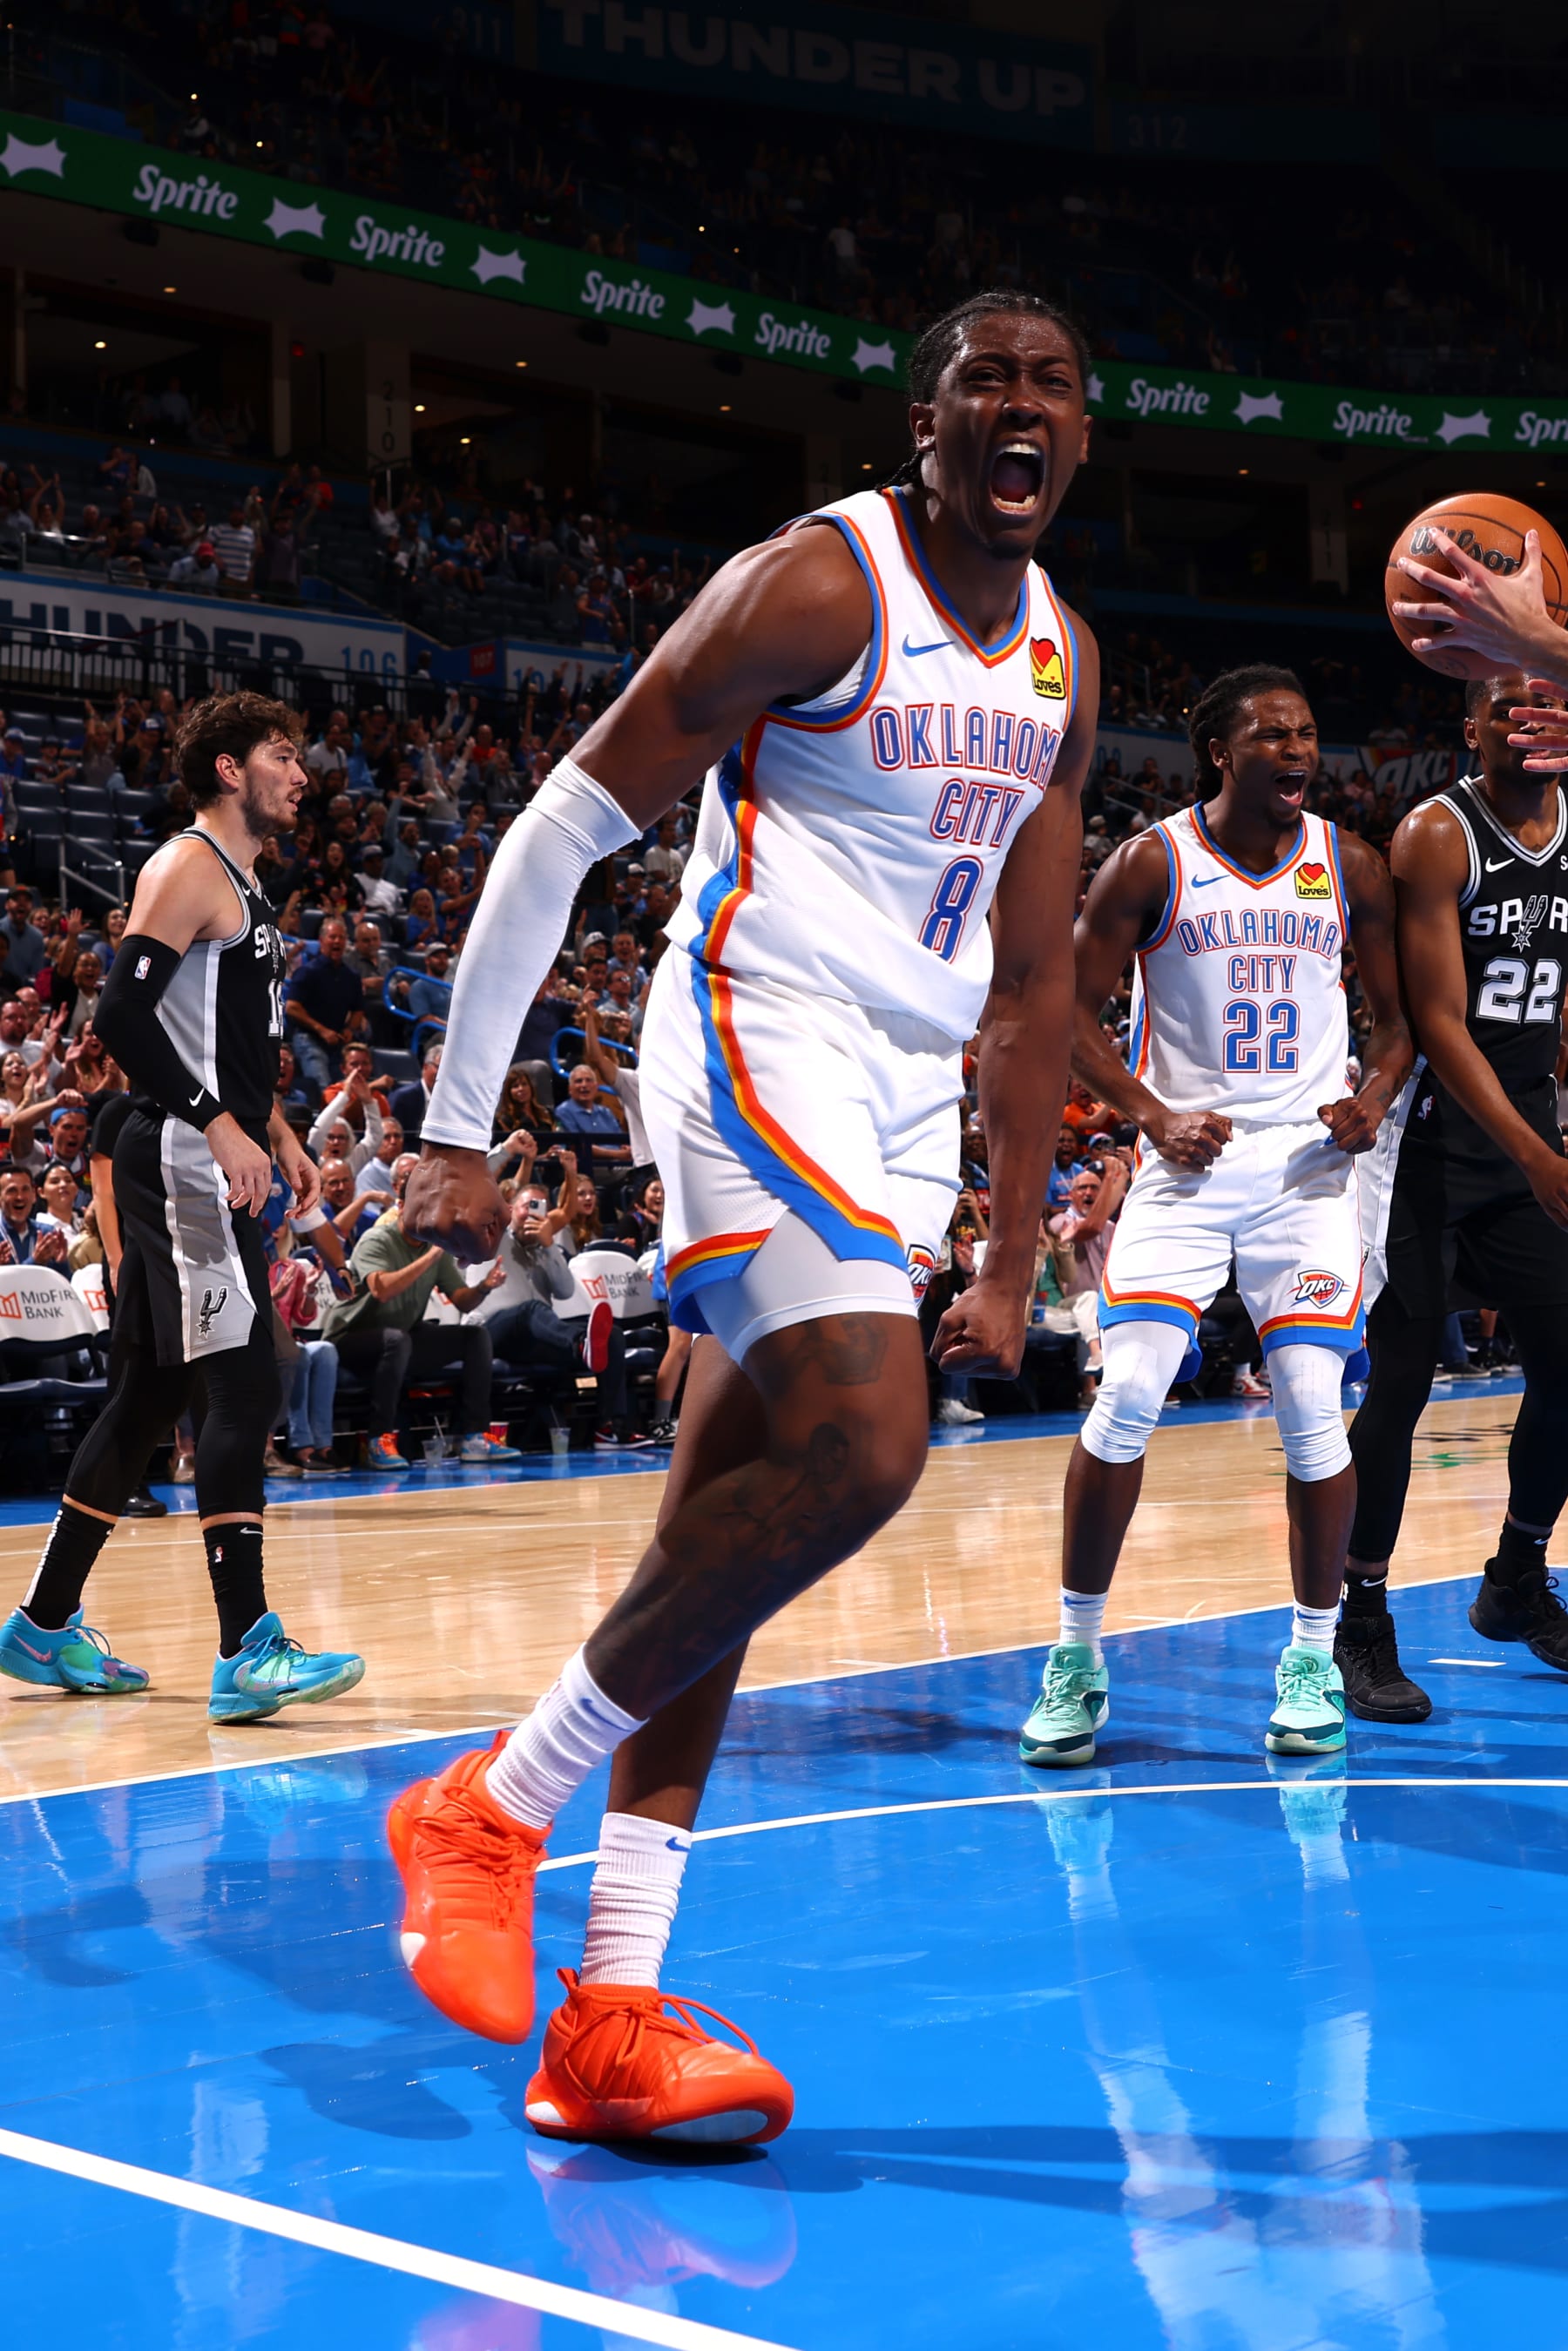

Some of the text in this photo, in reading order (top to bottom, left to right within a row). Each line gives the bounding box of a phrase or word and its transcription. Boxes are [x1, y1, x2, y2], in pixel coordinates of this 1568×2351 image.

[544, 0, 1086, 116] THUNDER UP
[132, 163, 239, 220] Sprite
[349, 214, 445, 267] Sprite
[580, 269, 666, 320] Sprite
[754, 311, 832, 359] Sprite
[1125, 377, 1211, 417] Sprite
[1333, 399, 1413, 438] Sprite
[1514, 410, 1568, 448] Spr
[869, 702, 1062, 793] OKLAHOM
[1374, 750, 1451, 801] OKC
[929, 778, 1025, 848] CITY
[918, 855, 984, 964] 8
[1176, 909, 1341, 961] OKLAHOMA
[1228, 954, 1297, 994] CITY
[1476, 956, 1563, 1024] 22
[1222, 998, 1301, 1074] 22
[1297, 1279, 1335, 1300] OKC
